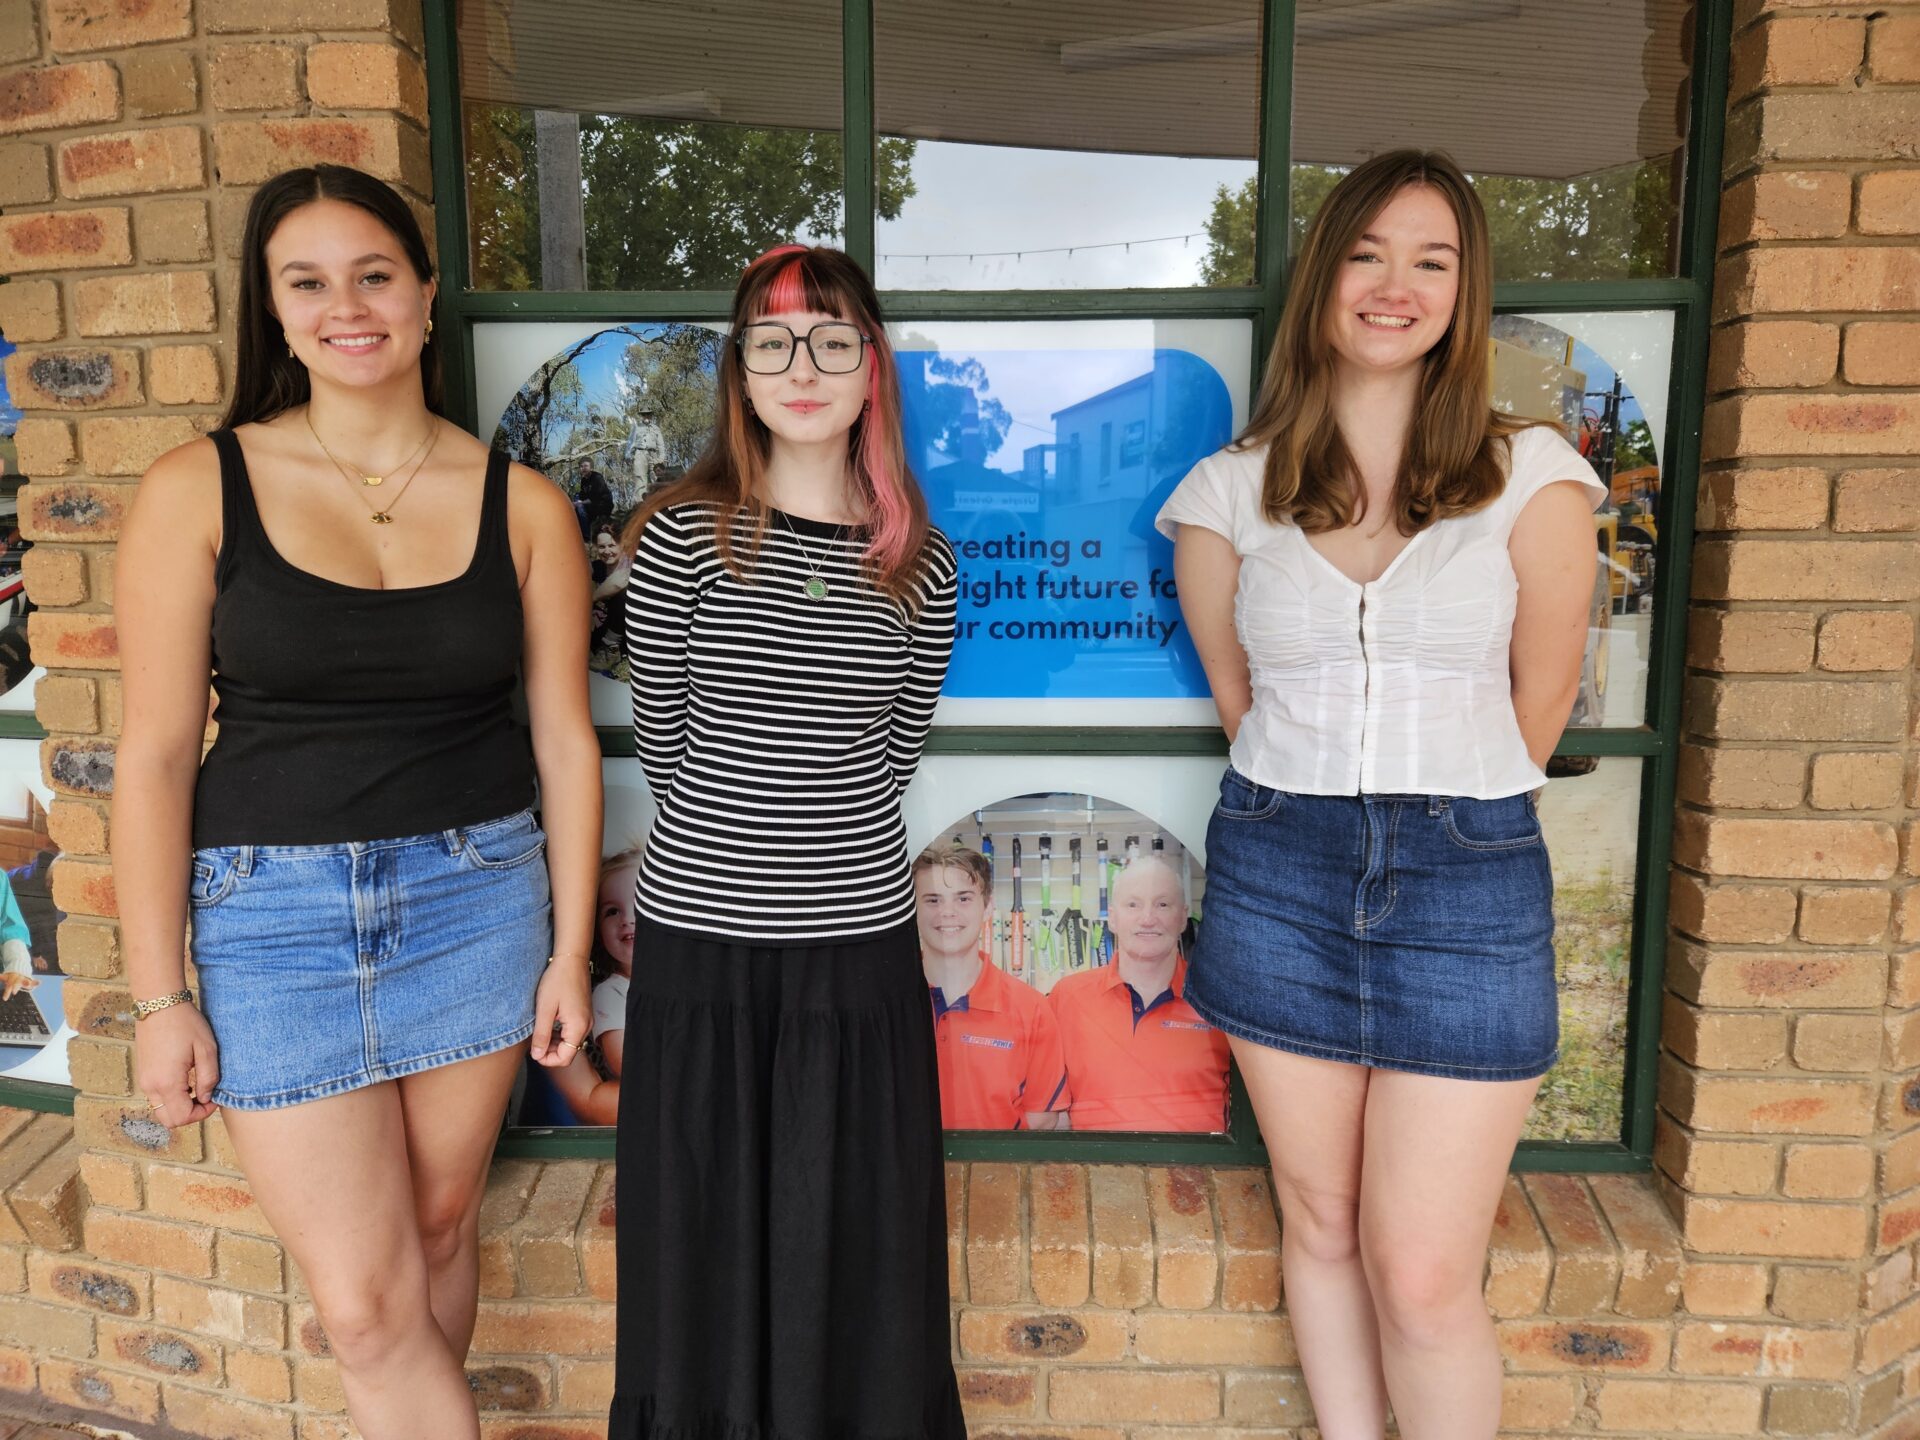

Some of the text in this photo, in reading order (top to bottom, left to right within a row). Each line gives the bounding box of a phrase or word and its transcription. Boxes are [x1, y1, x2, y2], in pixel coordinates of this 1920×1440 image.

[1081, 539, 1101, 558] a
[957, 570, 1027, 607] ight
[1036, 569, 1139, 599] future
[988, 612, 1179, 647] community
